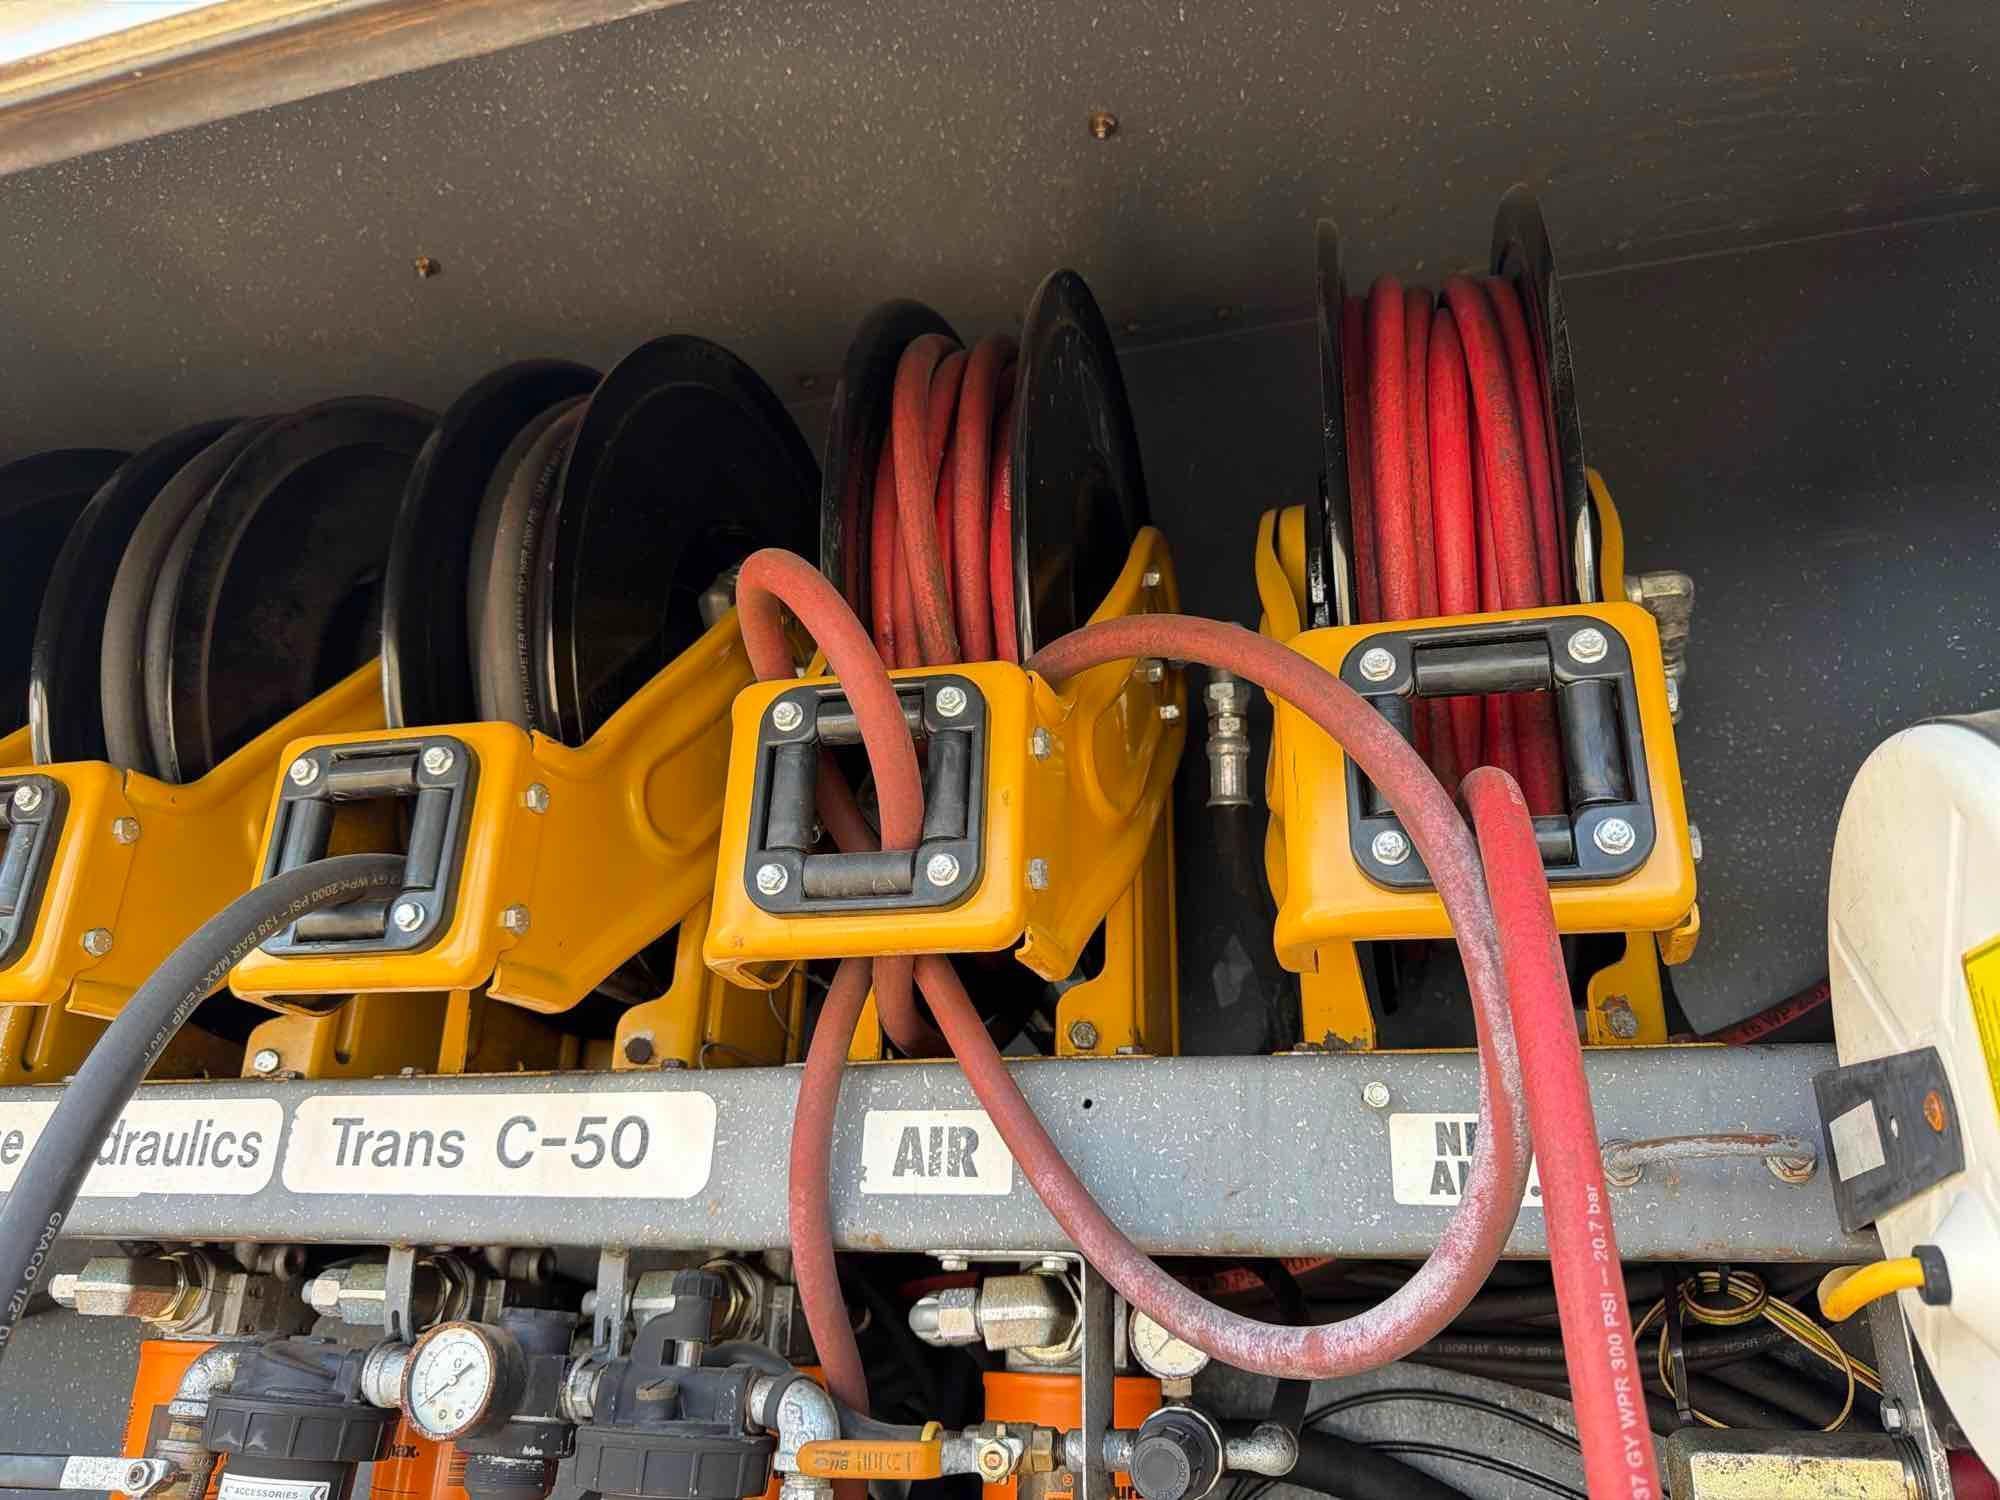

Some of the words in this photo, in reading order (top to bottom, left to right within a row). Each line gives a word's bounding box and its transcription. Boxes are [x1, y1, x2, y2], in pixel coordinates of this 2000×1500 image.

[229, 930, 257, 958] BAR
[201, 955, 231, 986] MAX
[332, 1117, 466, 1169] Trans
[496, 1115, 651, 1170] C-50
[892, 1126, 979, 1178] AIR
[1586, 1183, 1601, 1215] bar
[24, 1211, 62, 1280] GRACO
[1588, 1220, 1610, 1263] 20.7
[1600, 1291, 1622, 1329] PSI
[1608, 1333, 1628, 1371] 300
[1614, 1376, 1638, 1431] WPR
[1623, 1434, 1645, 1470] GY
